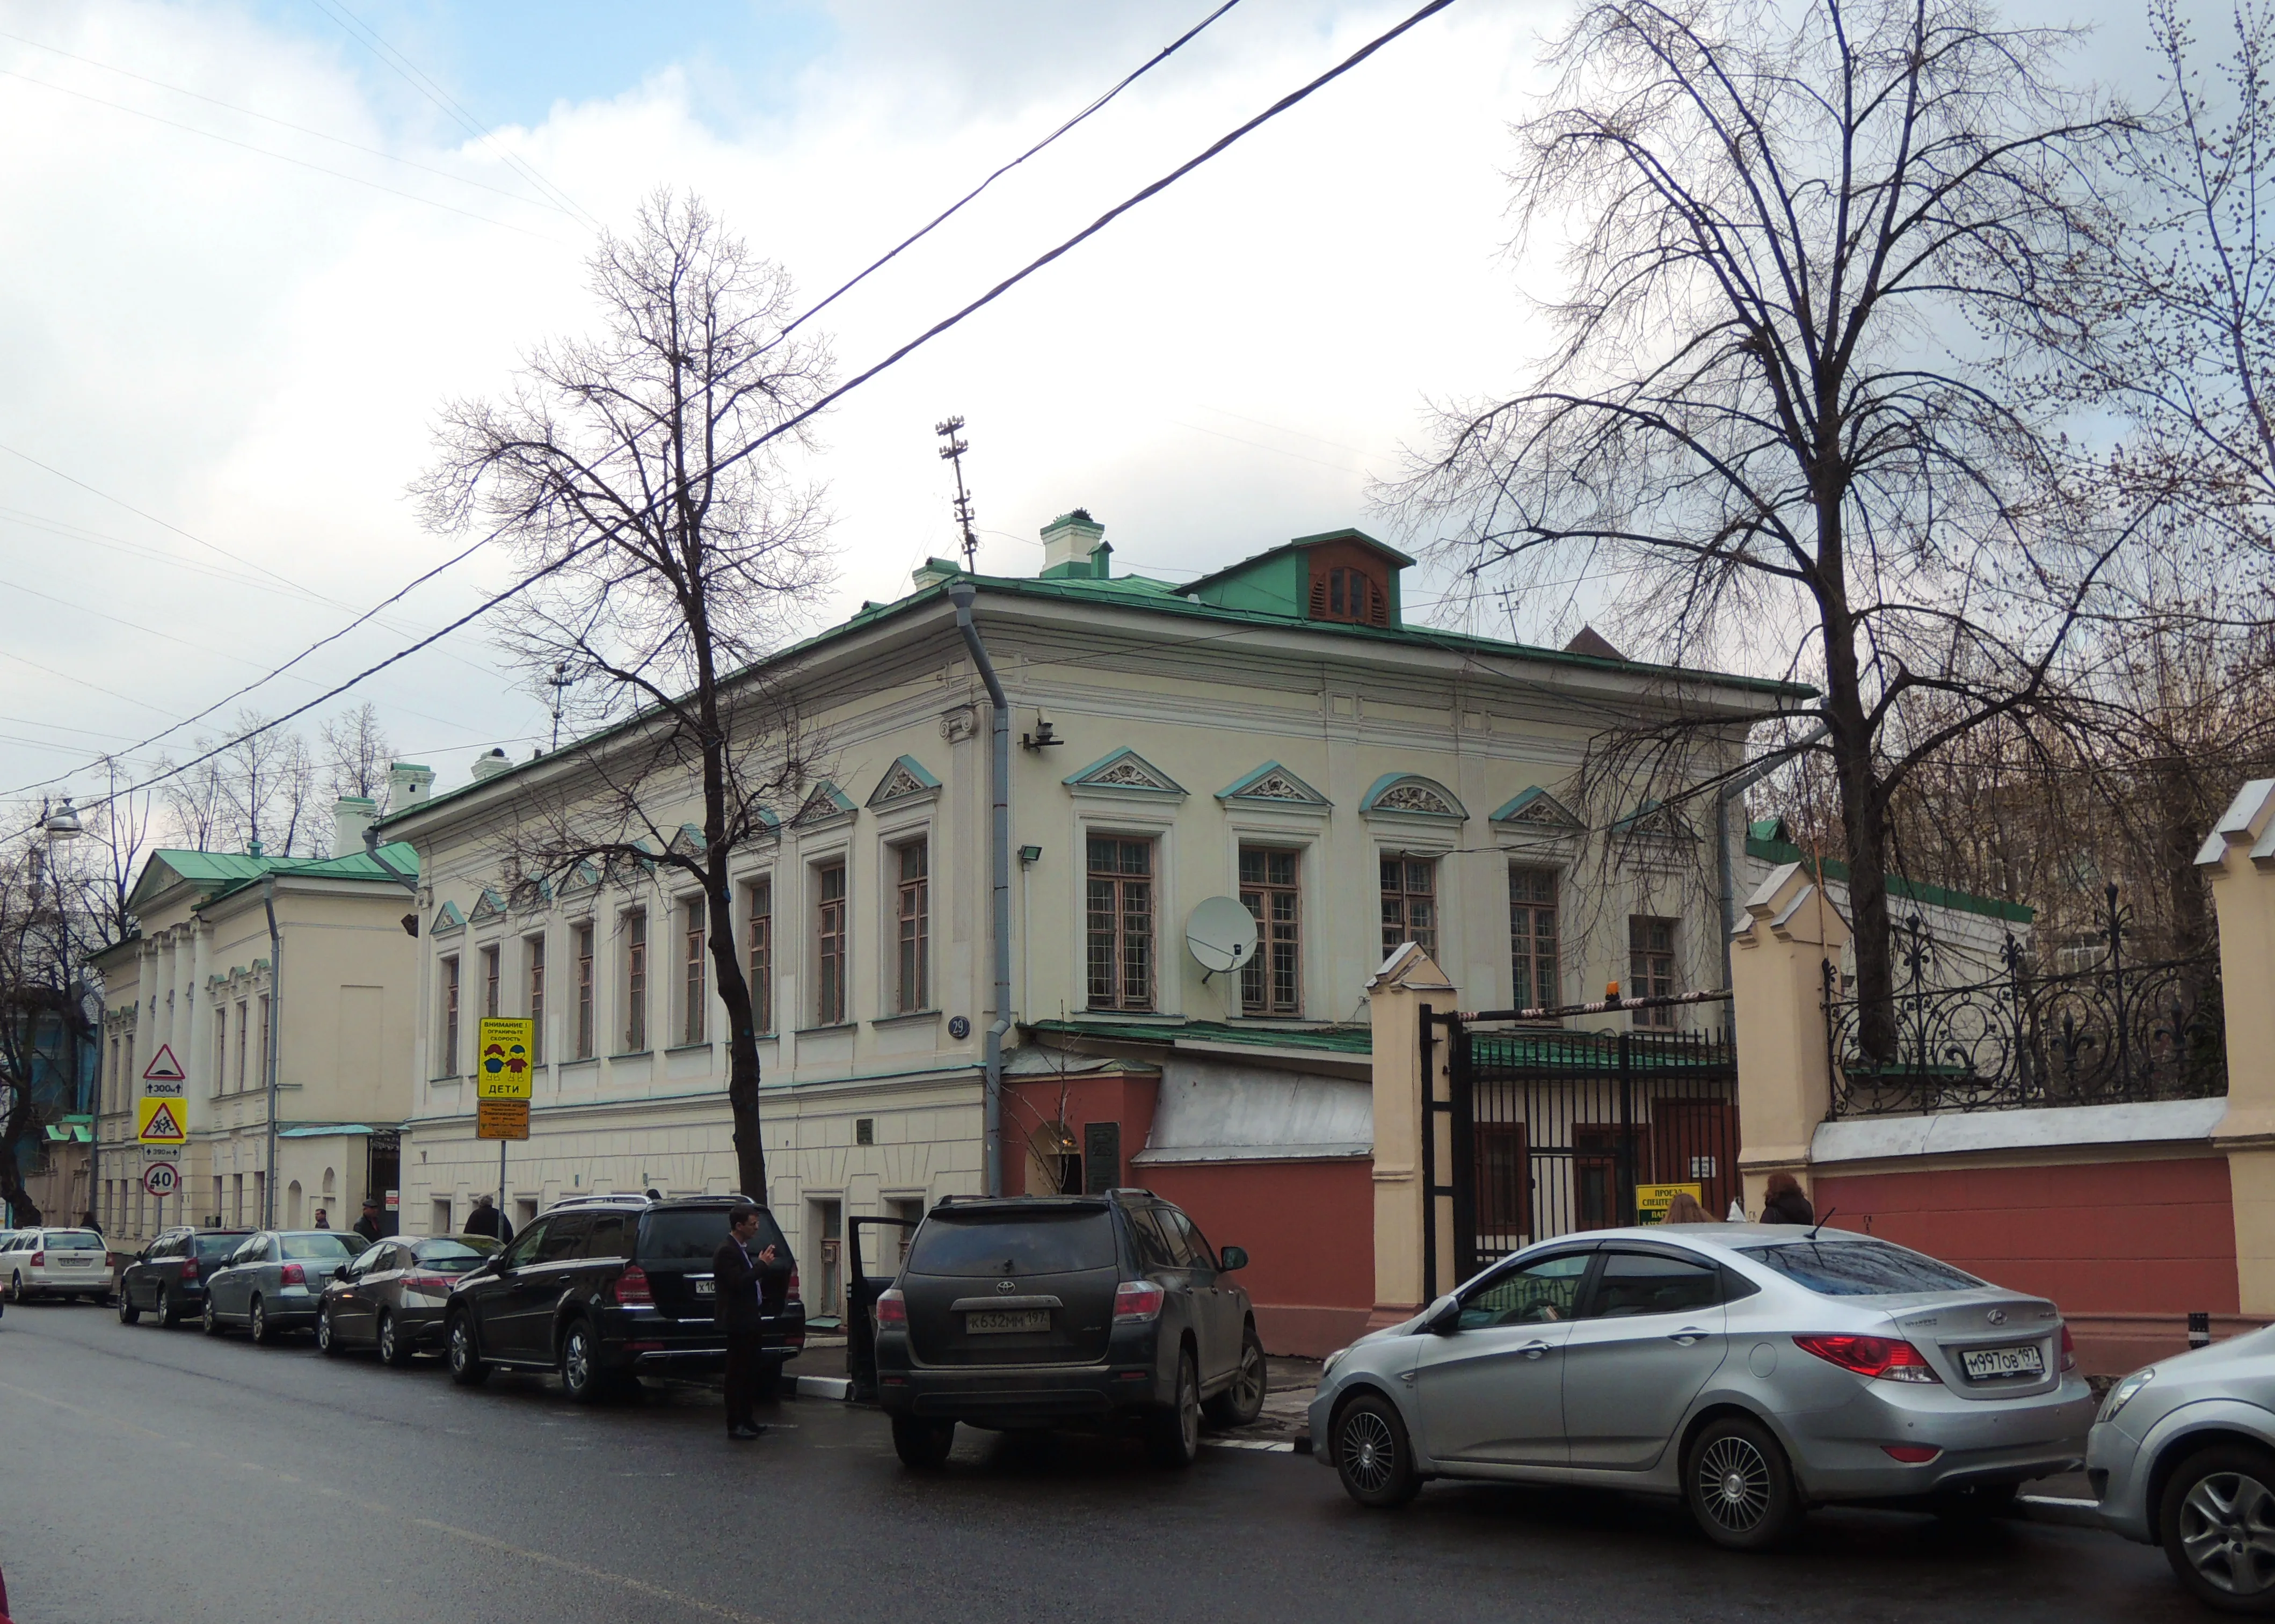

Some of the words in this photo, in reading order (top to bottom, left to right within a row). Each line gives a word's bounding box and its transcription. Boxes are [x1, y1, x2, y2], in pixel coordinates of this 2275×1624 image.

[953, 1019, 963, 1033] 29
[488, 1084, 519, 1095] ДЕТИ
[150, 1173, 171, 1186] 40
[1642, 1198, 1671, 1206] СПЕЦТЕ
[971, 1314, 1024, 1329] К632ММ
[1026, 1311, 1045, 1323] 197
[1968, 1351, 2019, 1373] М997ОВ
[2018, 1348, 2035, 1362] 197
